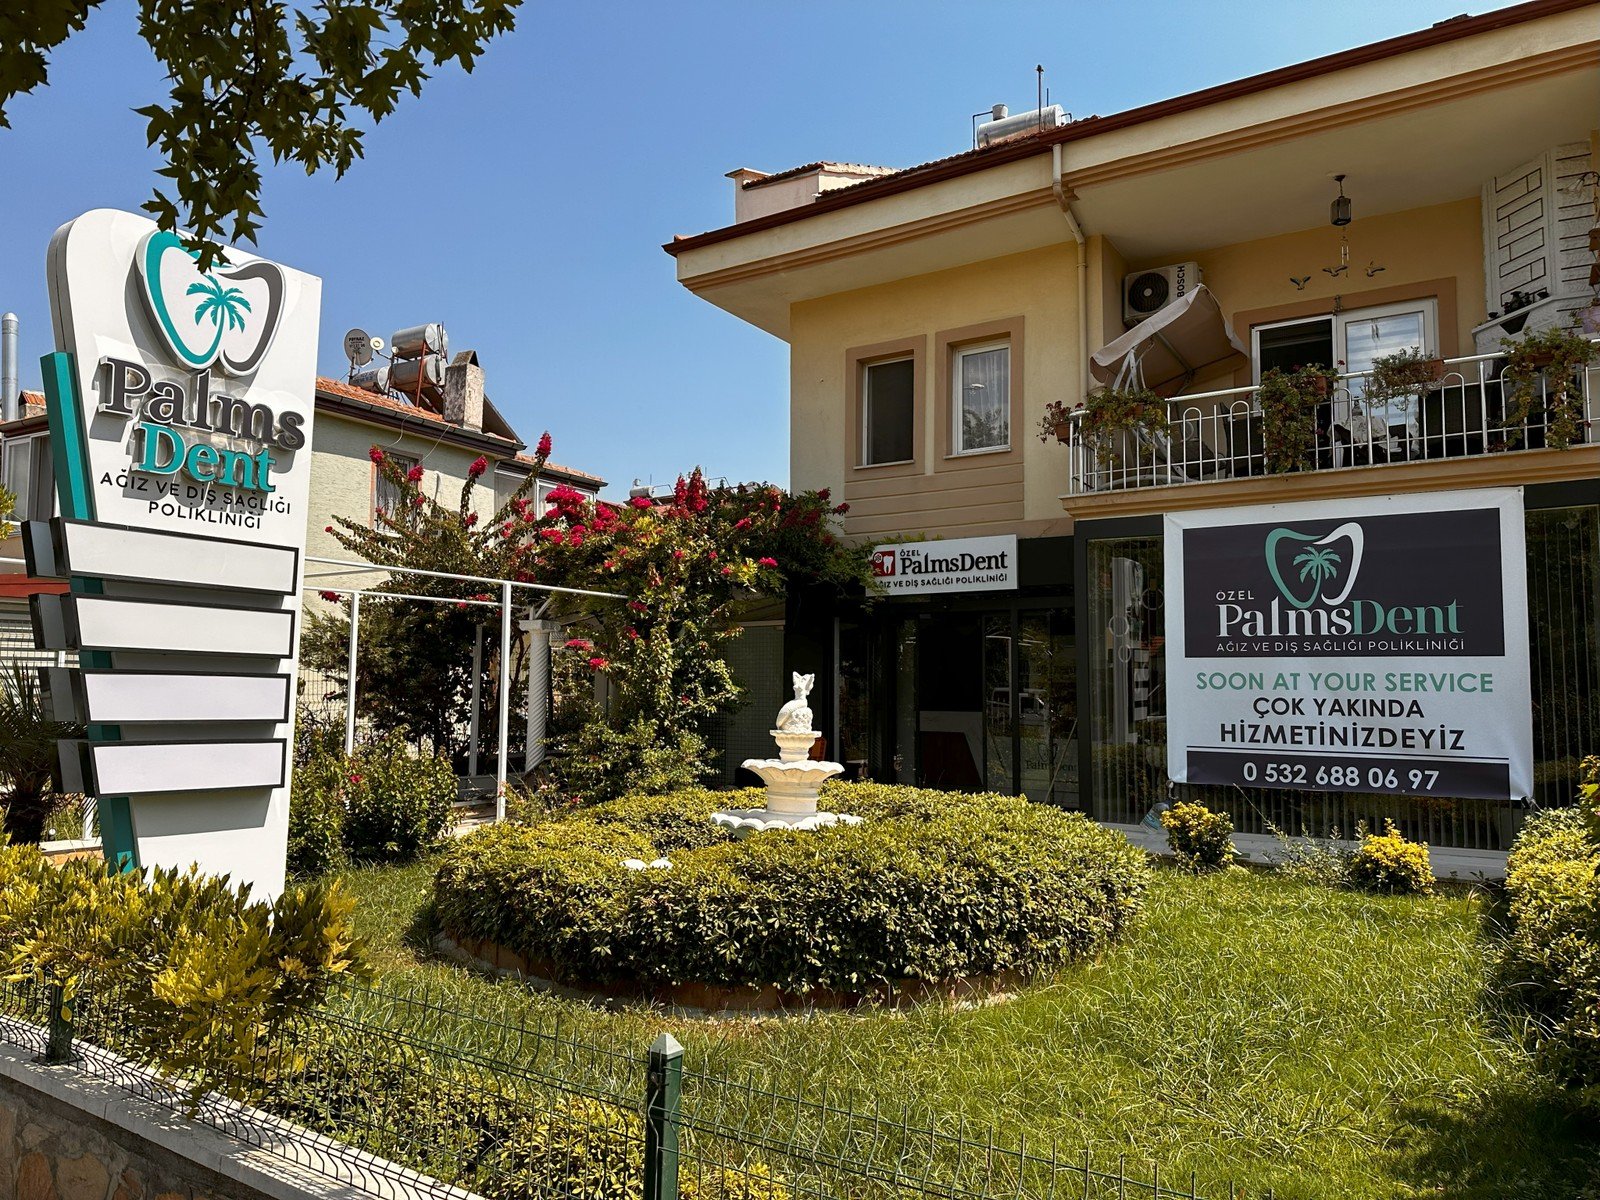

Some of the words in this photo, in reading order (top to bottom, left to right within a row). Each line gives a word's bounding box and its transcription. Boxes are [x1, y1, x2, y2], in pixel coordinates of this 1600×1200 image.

[1177, 266, 1185, 297] BOSCH
[100, 356, 305, 450] Palms
[132, 422, 276, 492] Dent
[100, 468, 148, 491] AĞIZ
[155, 480, 180, 496] VE
[187, 484, 216, 504] DİŞ
[223, 490, 291, 514] SAĞLIĞI
[149, 501, 261, 529] POLİKLİNİĞİ
[900, 551, 1008, 575] PalmsDent
[906, 579, 918, 587] DİŞ
[921, 576, 953, 586] SAĞLIĞI
[956, 573, 1007, 584] POLİKLİNİĞİ
[1216, 589, 1254, 601] ÖZEL
[1216, 596, 1465, 637] PalmsDent
[1216, 640, 1248, 652] AĞIZ
[1251, 641, 1271, 652] VE
[1275, 639, 1298, 653] DİŞ
[1303, 638, 1362, 651] SAĞLIĞI
[1368, 637, 1465, 651] POLİKLİNİĞİ
[1196, 672, 1264, 691] SOON
[1273, 672, 1300, 691] AT
[1308, 672, 1376, 692] YOUR
[1385, 673, 1493, 693] SERVICE
[1253, 697, 1305, 718] ÇOK
[1313, 698, 1424, 718] YAKINDA
[1221, 720, 1465, 751] HİZMETİNİZDEYİZ
[1243, 762, 1257, 781] 0
[1265, 764, 1307, 784] 532
[1316, 766, 1359, 786] 688
[1368, 768, 1398, 788] 06
[1408, 770, 1440, 790] 97
